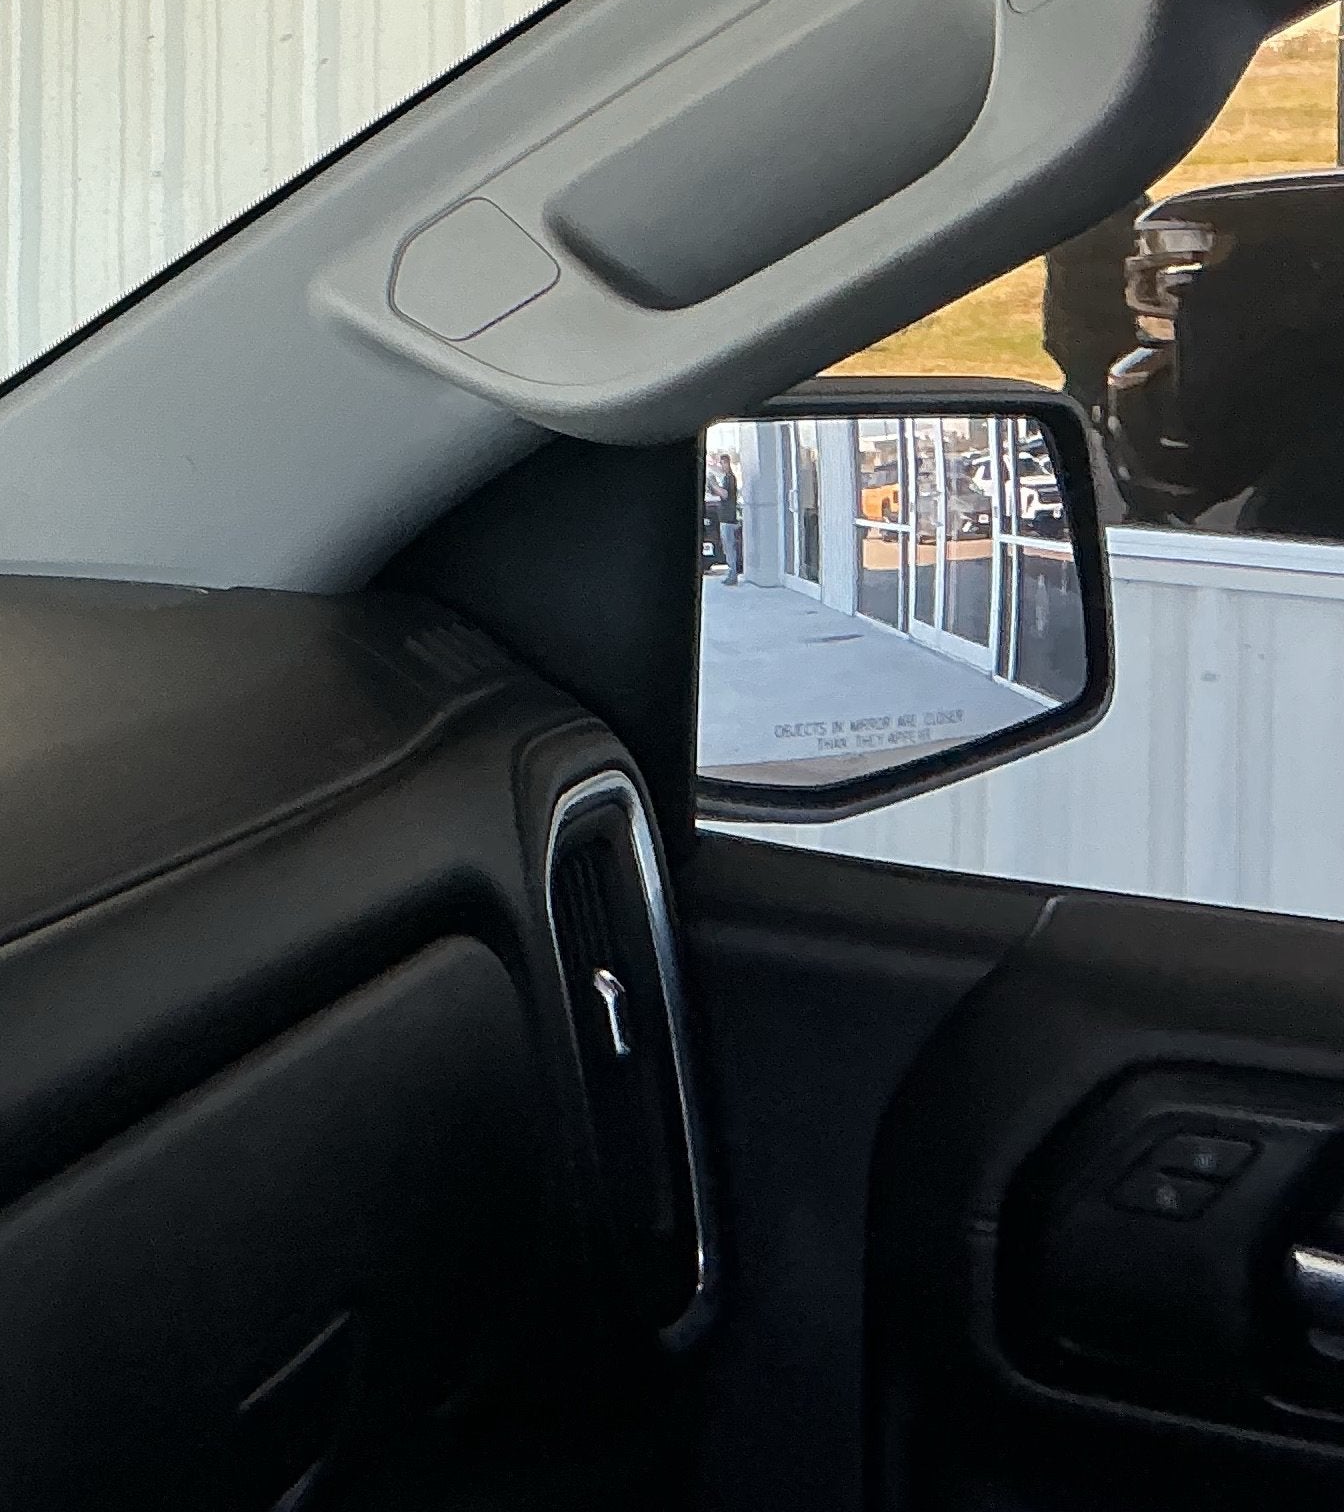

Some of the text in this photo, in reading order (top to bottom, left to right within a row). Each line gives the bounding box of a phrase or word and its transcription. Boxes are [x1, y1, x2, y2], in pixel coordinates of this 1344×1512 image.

[774, 721, 826, 738] OBJECTS
[831, 720, 844, 734] IN
[850, 716, 890, 732] MIRROR
[897, 714, 917, 728] ARE
